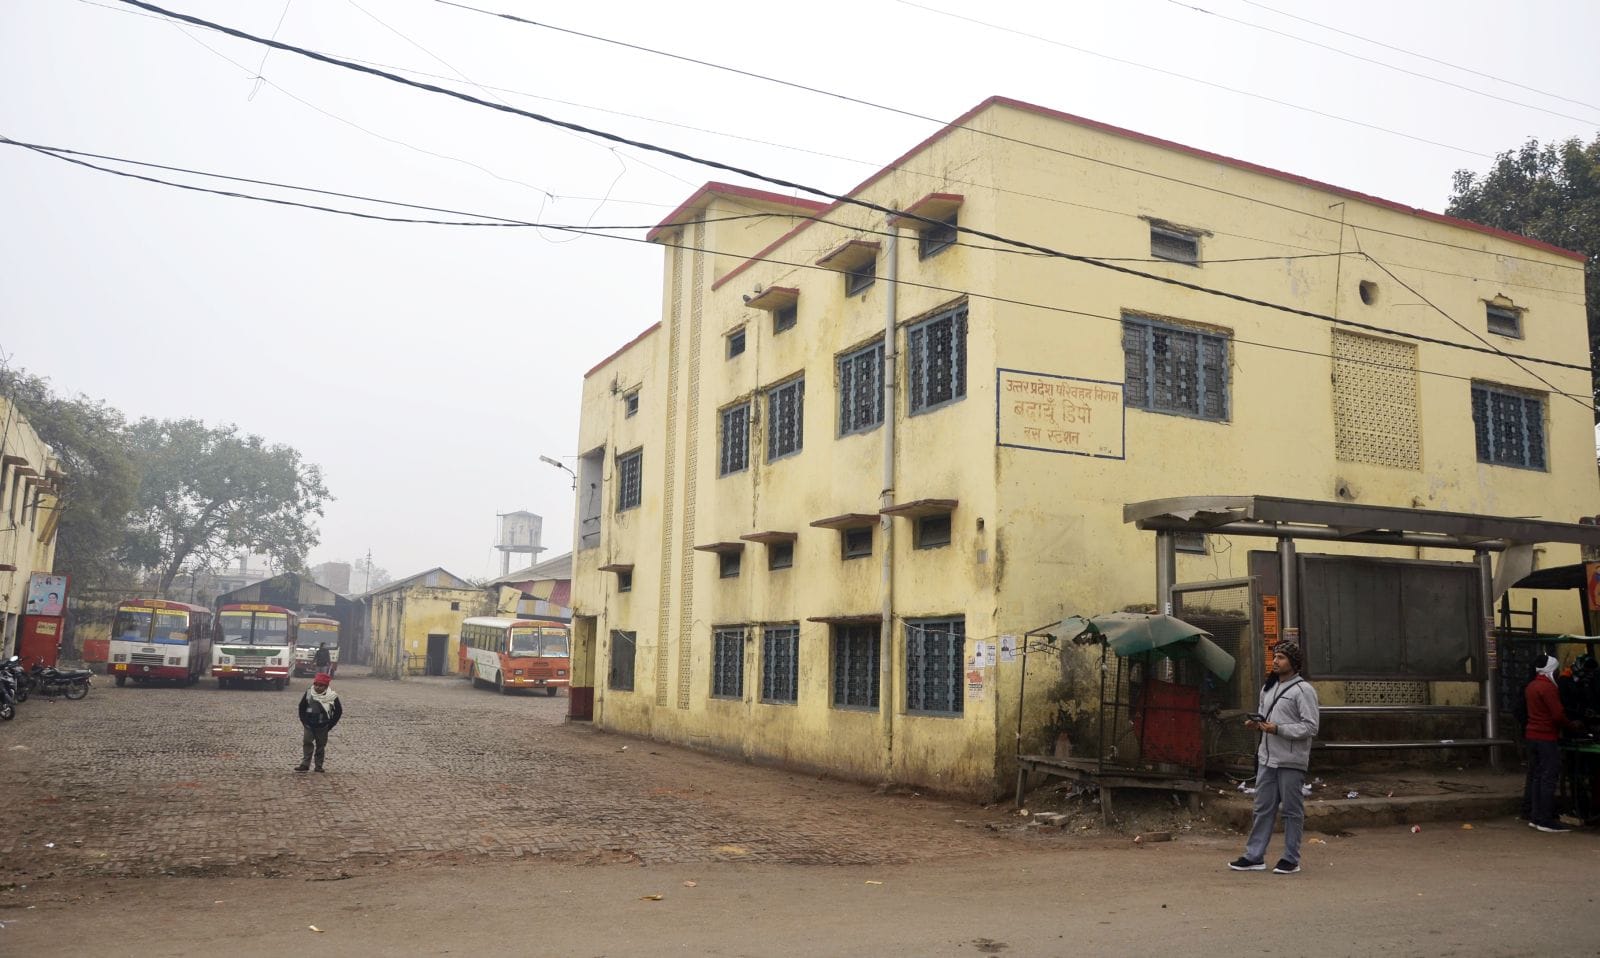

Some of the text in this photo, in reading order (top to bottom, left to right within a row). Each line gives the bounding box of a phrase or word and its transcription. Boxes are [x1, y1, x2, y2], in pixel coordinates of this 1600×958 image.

[1006, 379, 1120, 402] उत्तर प्रदेश परिवहन निगम
[1062, 399, 1093, 424] डिपो
